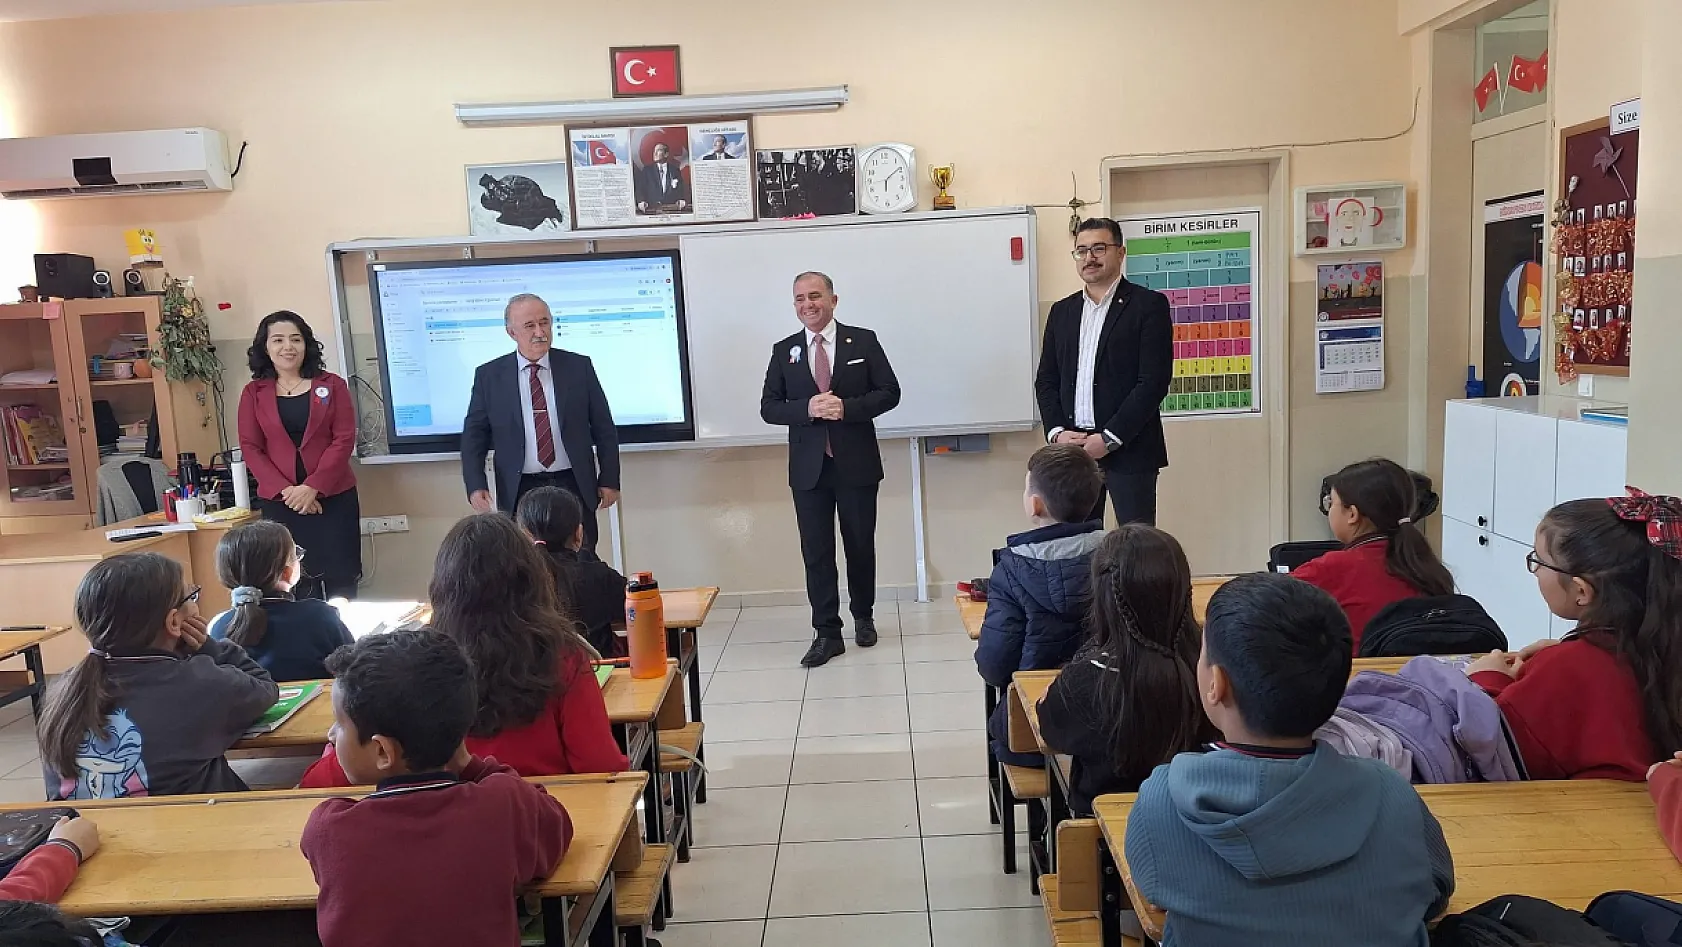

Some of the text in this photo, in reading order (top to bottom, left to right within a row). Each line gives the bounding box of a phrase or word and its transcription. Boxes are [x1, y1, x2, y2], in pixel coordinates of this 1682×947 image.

[1618, 111, 1638, 125] Size
[880, 152, 889, 160] 12
[1144, 218, 1239, 234] BİRİM KESİRLER
